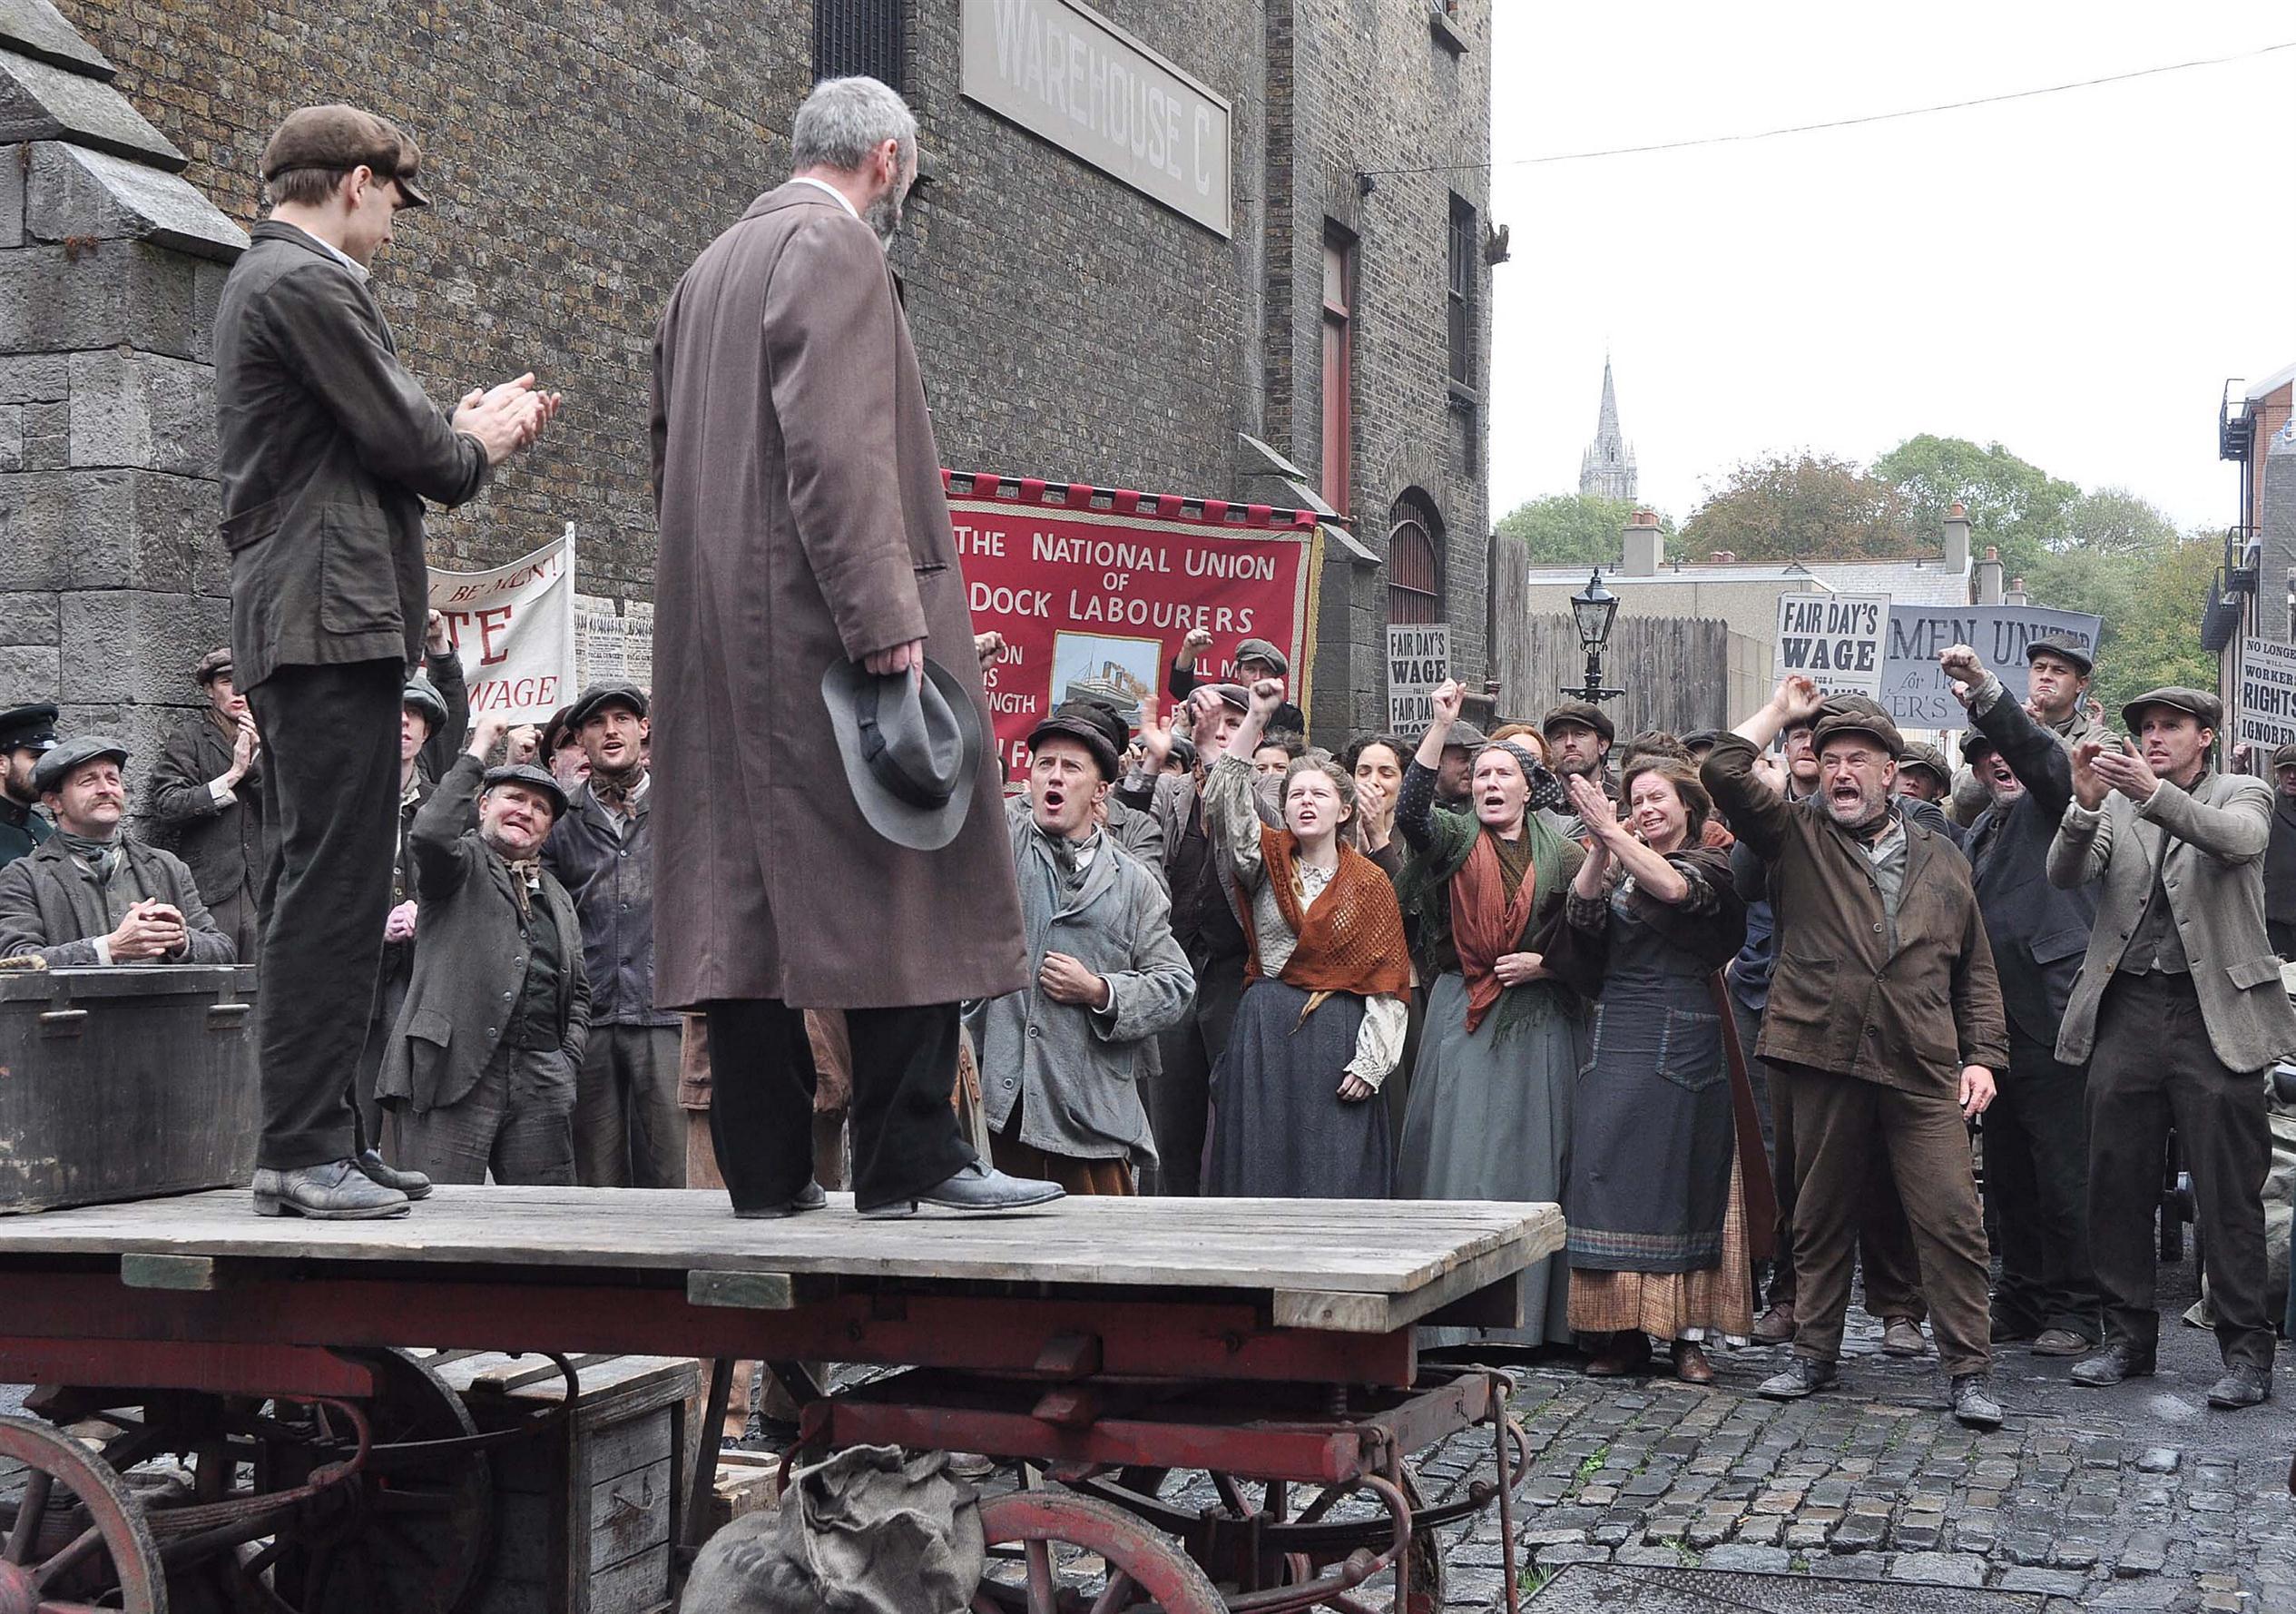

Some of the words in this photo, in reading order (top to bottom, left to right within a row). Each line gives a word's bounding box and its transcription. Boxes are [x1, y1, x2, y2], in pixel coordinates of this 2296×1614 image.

[993, 0, 1182, 181] WAREHOUSE
[1193, 103, 1211, 196] C
[954, 526, 1006, 557] THE
[1032, 533, 1171, 574] NATIONAL
[1185, 548, 1276, 581] UNION
[449, 585, 486, 603] BE
[1103, 572, 1129, 591] OF
[970, 582, 1052, 617] DOCK
[1069, 588, 1254, 634] LABOURERS
[1830, 594, 1836, 602] A
[1783, 603, 1823, 634] FAIR
[1827, 603, 1879, 635] DAY'S
[1390, 633, 1413, 656] FAIR
[1416, 632, 1445, 656] DAY'S
[1885, 618, 1977, 660] MEN
[2246, 640, 2261, 652] NO
[2263, 644, 2296, 660] LONGE
[1781, 638, 1877, 672] WAGE
[1391, 660, 1447, 684] WAGE
[2245, 664, 2296, 686] WORKER
[466, 676, 558, 713] WAGE
[1392, 697, 1415, 721] FAIR
[1882, 695, 1948, 722] ER'S
